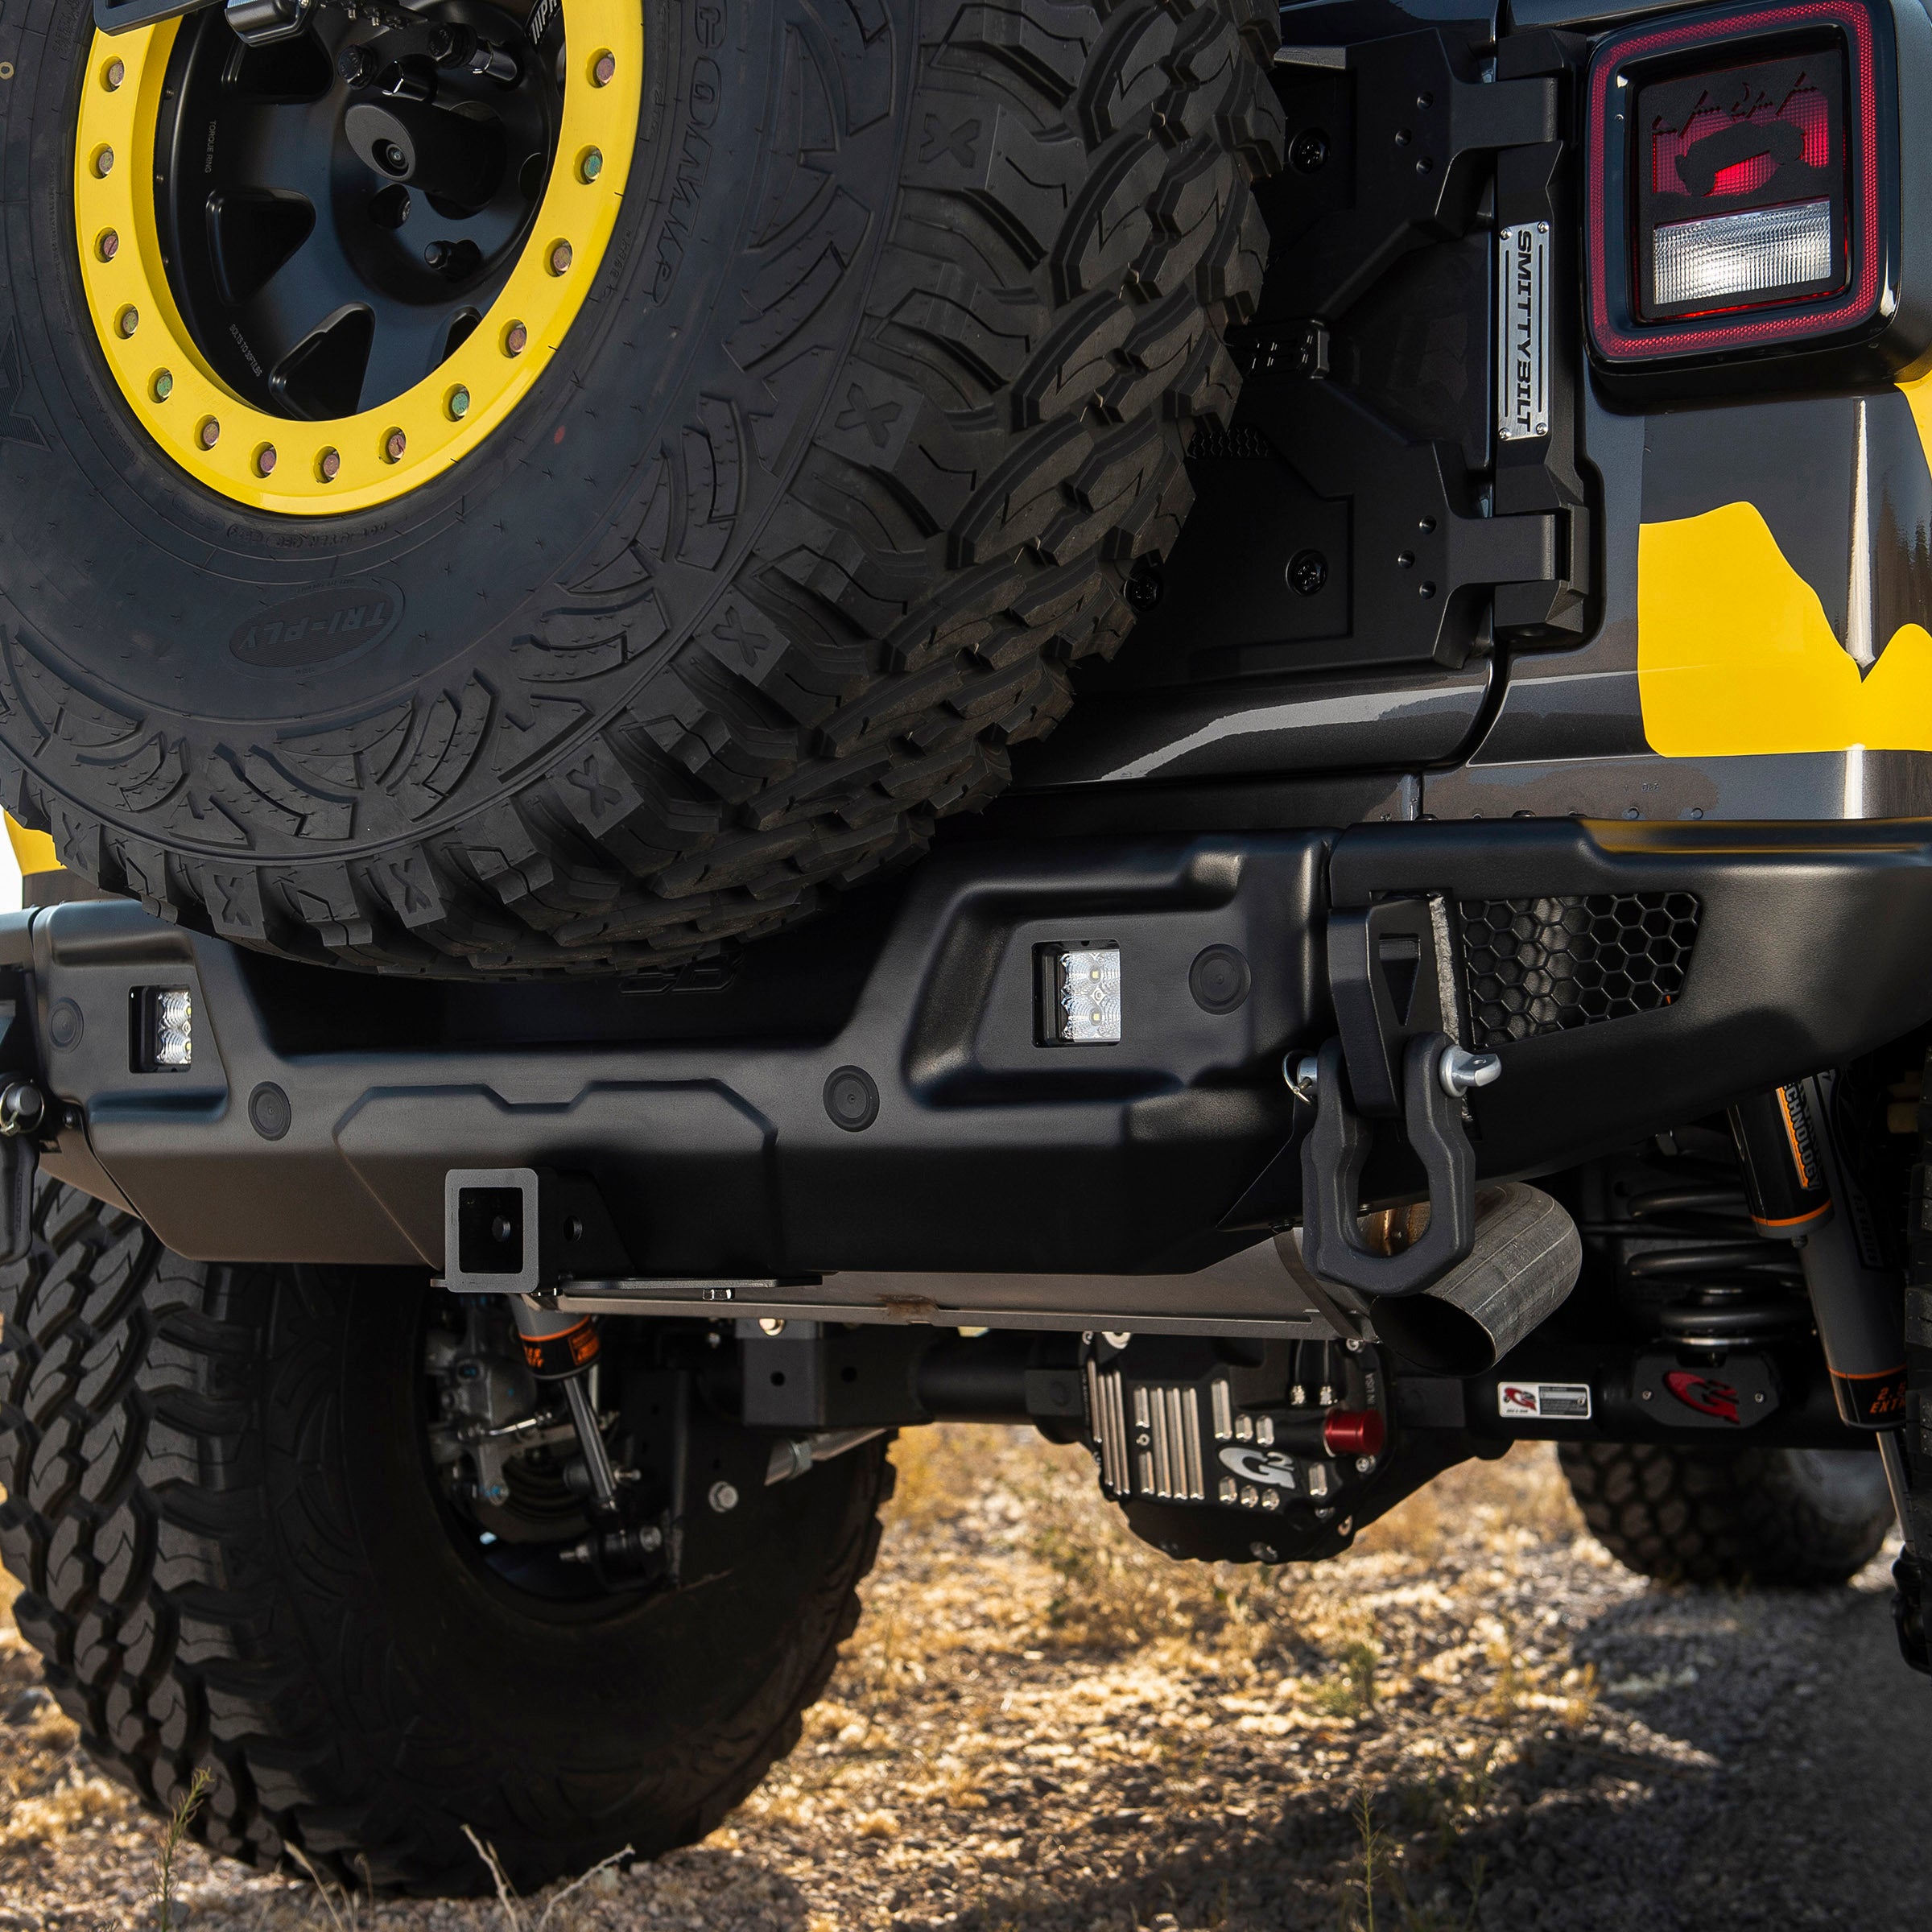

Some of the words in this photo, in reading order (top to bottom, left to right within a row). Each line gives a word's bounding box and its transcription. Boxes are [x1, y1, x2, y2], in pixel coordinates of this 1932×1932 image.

[207, 120, 217, 152] TORQUE
[204, 155, 213, 173] RING
[229, 324, 245, 345] BOLTS
[239, 341, 250, 353] TO
[1517, 229, 1533, 433] SMITTYBILT
[238, 601, 386, 650] TRI-PLY
[1365, 1373, 1376, 1393] USA
[1218, 1446, 1296, 1490] G2
